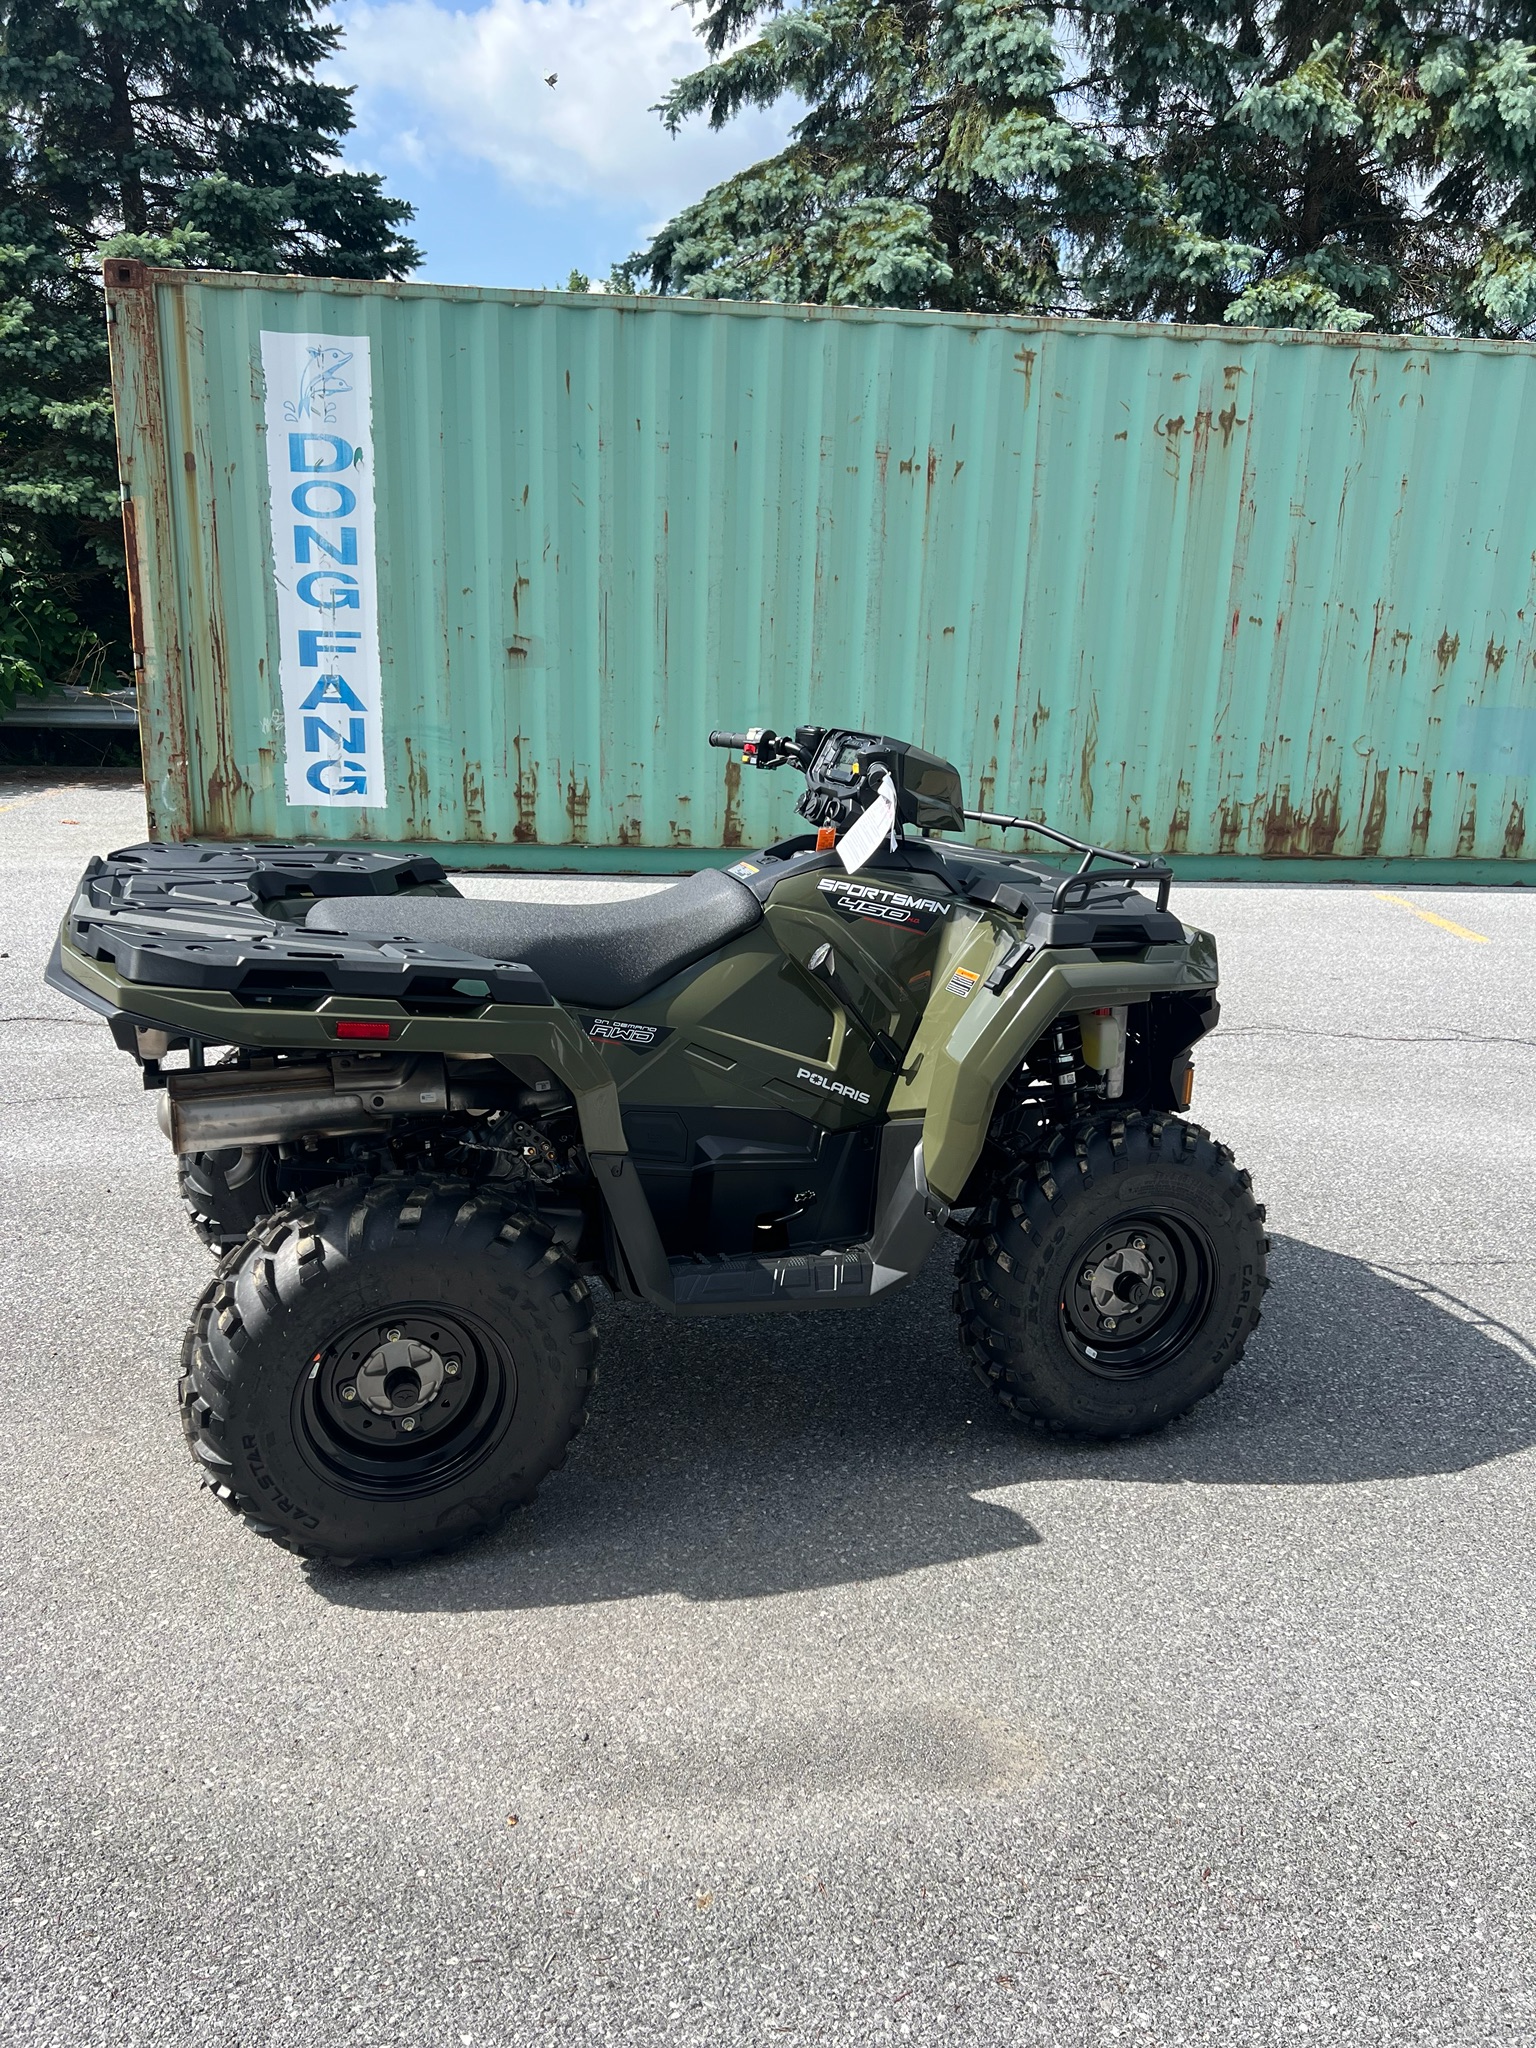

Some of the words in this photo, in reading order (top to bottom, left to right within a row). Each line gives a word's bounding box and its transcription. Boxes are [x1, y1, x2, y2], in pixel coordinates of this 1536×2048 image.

[288, 432, 361, 610] DONG
[298, 630, 368, 796] FANG
[816, 878, 951, 915] SPORTSMAN
[837, 896, 911, 922] 450
[589, 1024, 655, 1043] AWD
[594, 1018, 610, 1026] ON
[612, 1021, 657, 1032] DEMAND
[797, 1067, 871, 1104] POLARIS
[1212, 1264, 1253, 1364] CARLSTAR
[241, 1433, 321, 1530] CARLSTAR
